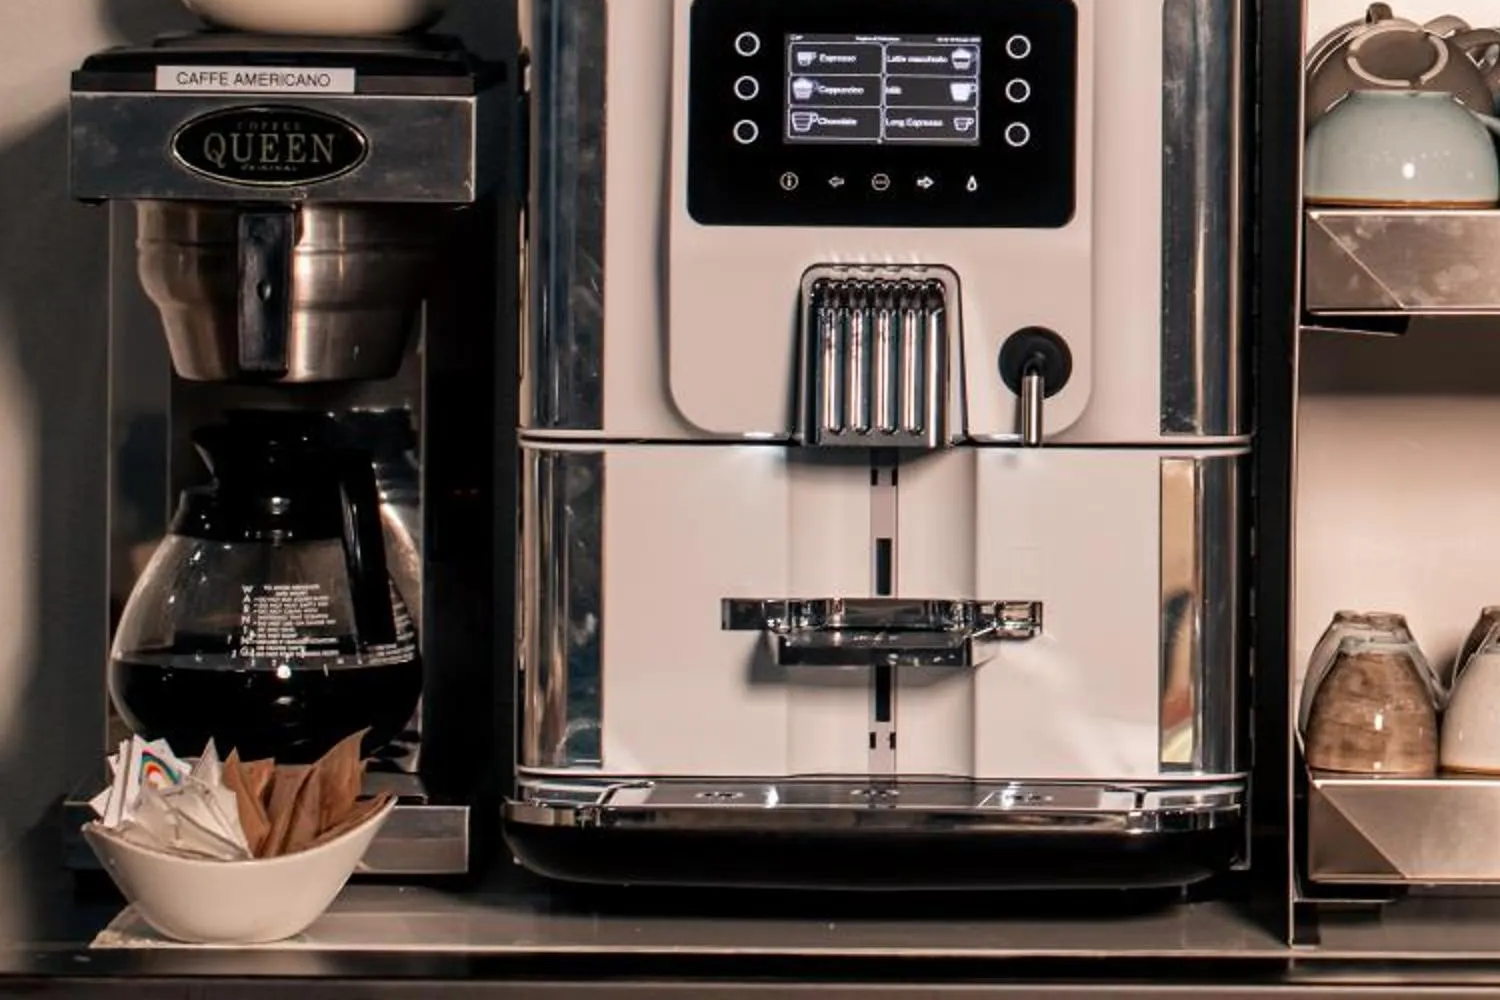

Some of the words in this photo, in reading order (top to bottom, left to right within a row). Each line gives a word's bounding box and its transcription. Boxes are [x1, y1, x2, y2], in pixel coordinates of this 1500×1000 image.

[175, 71, 229, 86] CAFFE
[233, 72, 332, 88] AMERICANO
[203, 132, 336, 168] QUEEN
